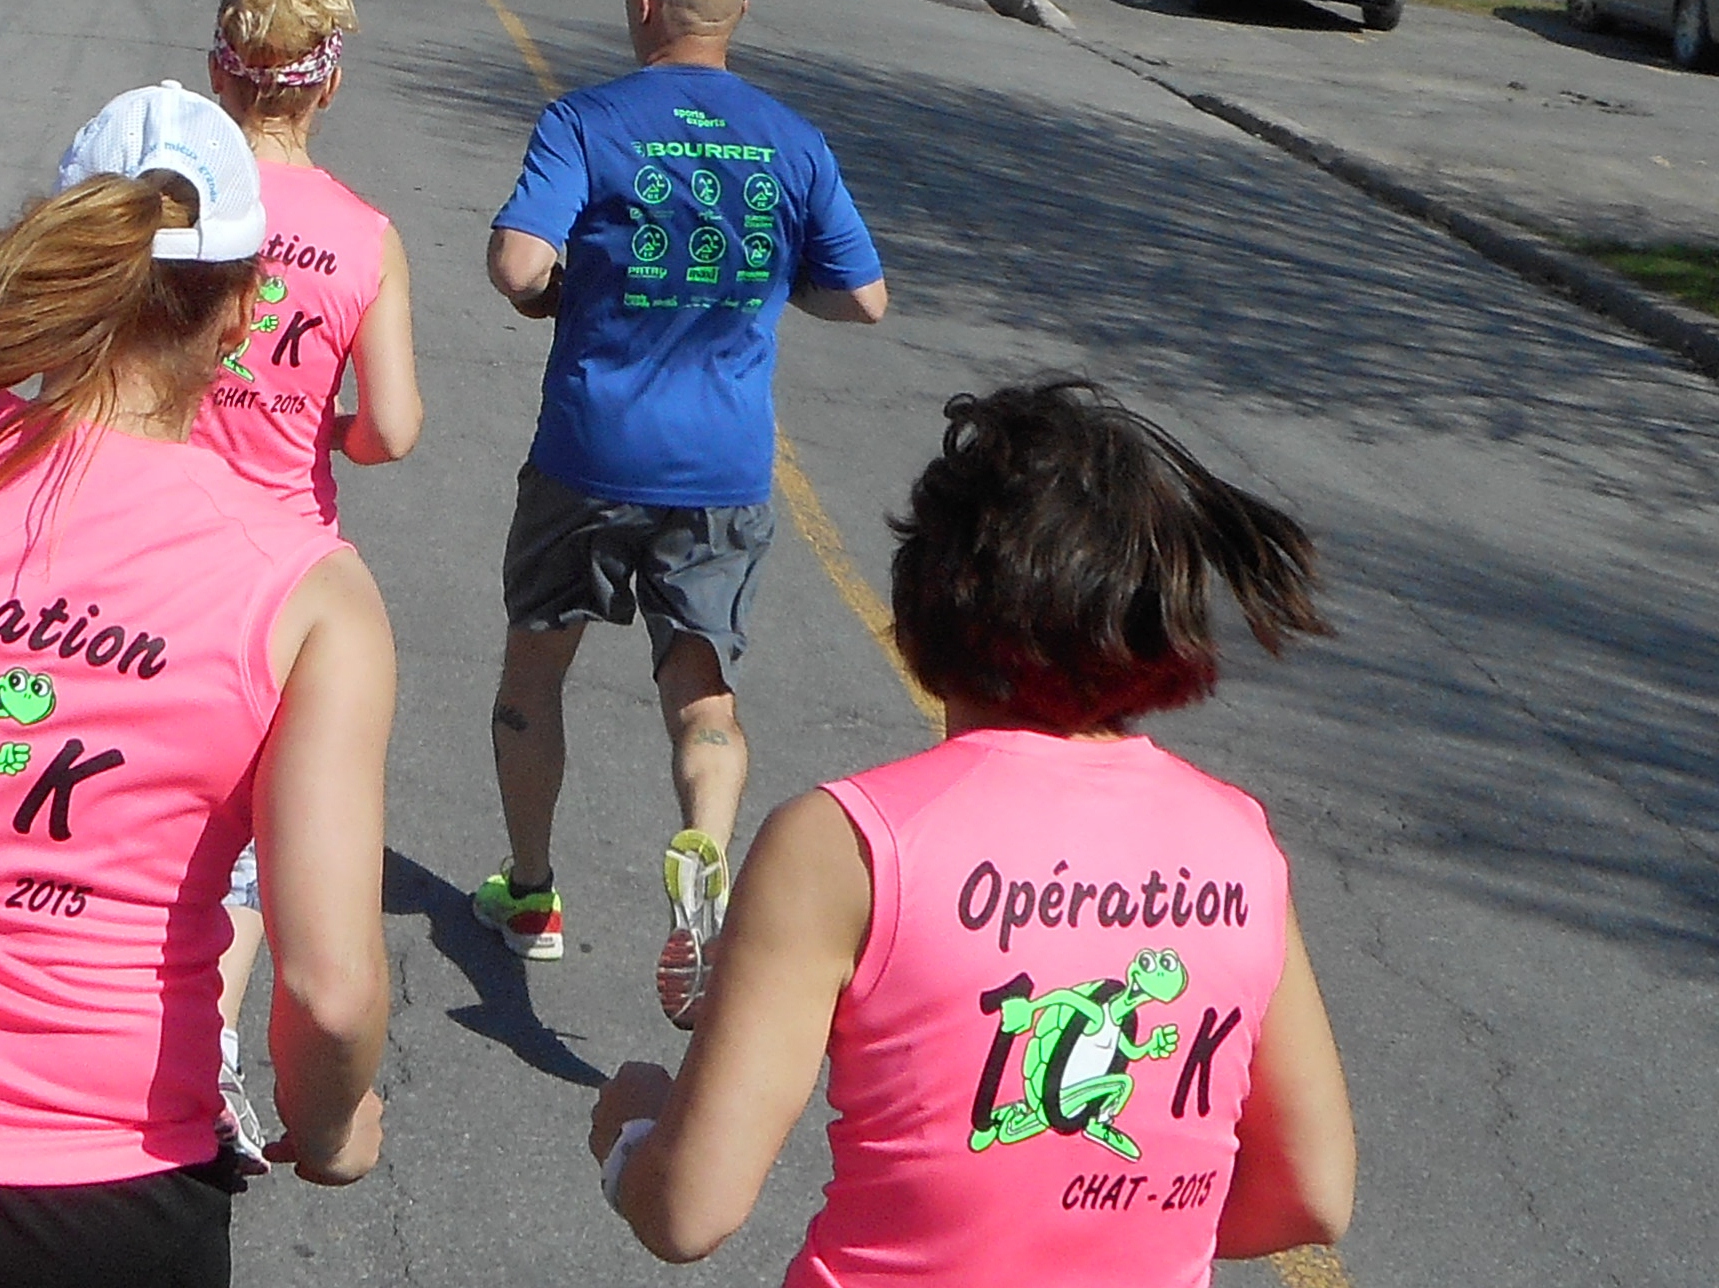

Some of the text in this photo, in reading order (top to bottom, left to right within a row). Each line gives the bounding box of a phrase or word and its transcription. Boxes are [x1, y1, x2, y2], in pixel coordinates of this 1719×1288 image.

[645, 141, 776, 163] BOURRET
[213, 387, 260, 410] CHAT
[270, 393, 307, 415] 2015
[5, 876, 94, 918] 2015
[957, 859, 1249, 953] Opération
[1062, 1174, 1148, 1212] CHAT
[1161, 1170, 1217, 1212] 2015
